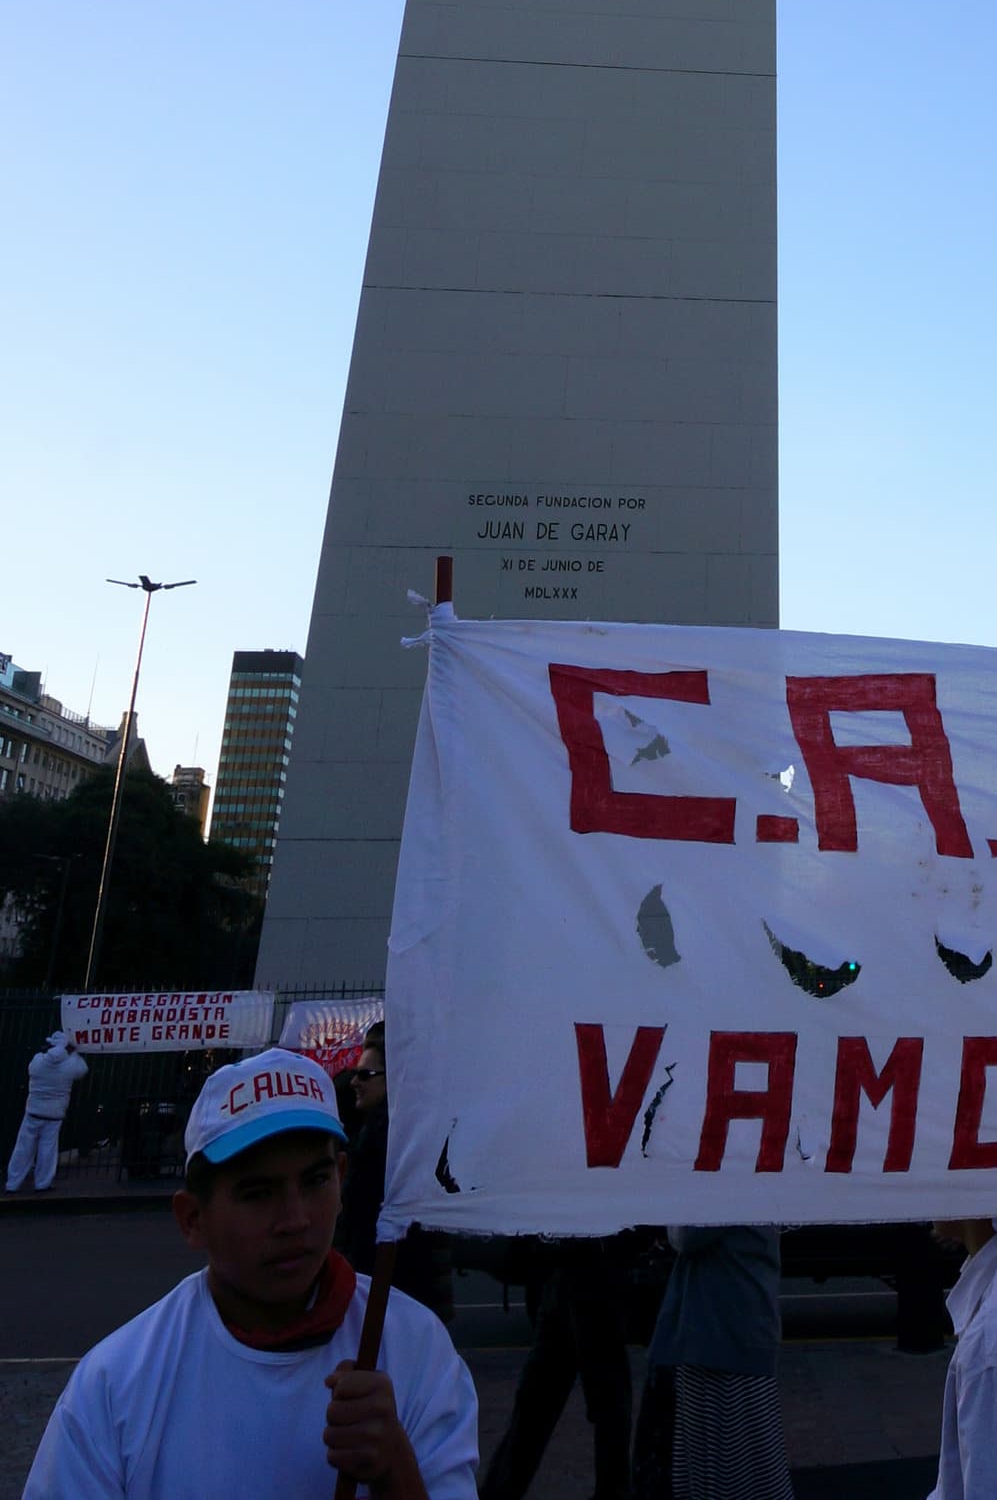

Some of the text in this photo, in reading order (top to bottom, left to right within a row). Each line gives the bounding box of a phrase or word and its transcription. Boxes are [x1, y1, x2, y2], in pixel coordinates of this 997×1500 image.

[468, 494, 646, 510] SEGUNDA FUNDACION POR
[477, 521, 631, 542] JUAN DE GARAY
[502, 558, 604, 573] XI DE JUNIO DE
[524, 586, 578, 600] MDLXXX
[75, 1024, 230, 1044] MONTE GRANDE
